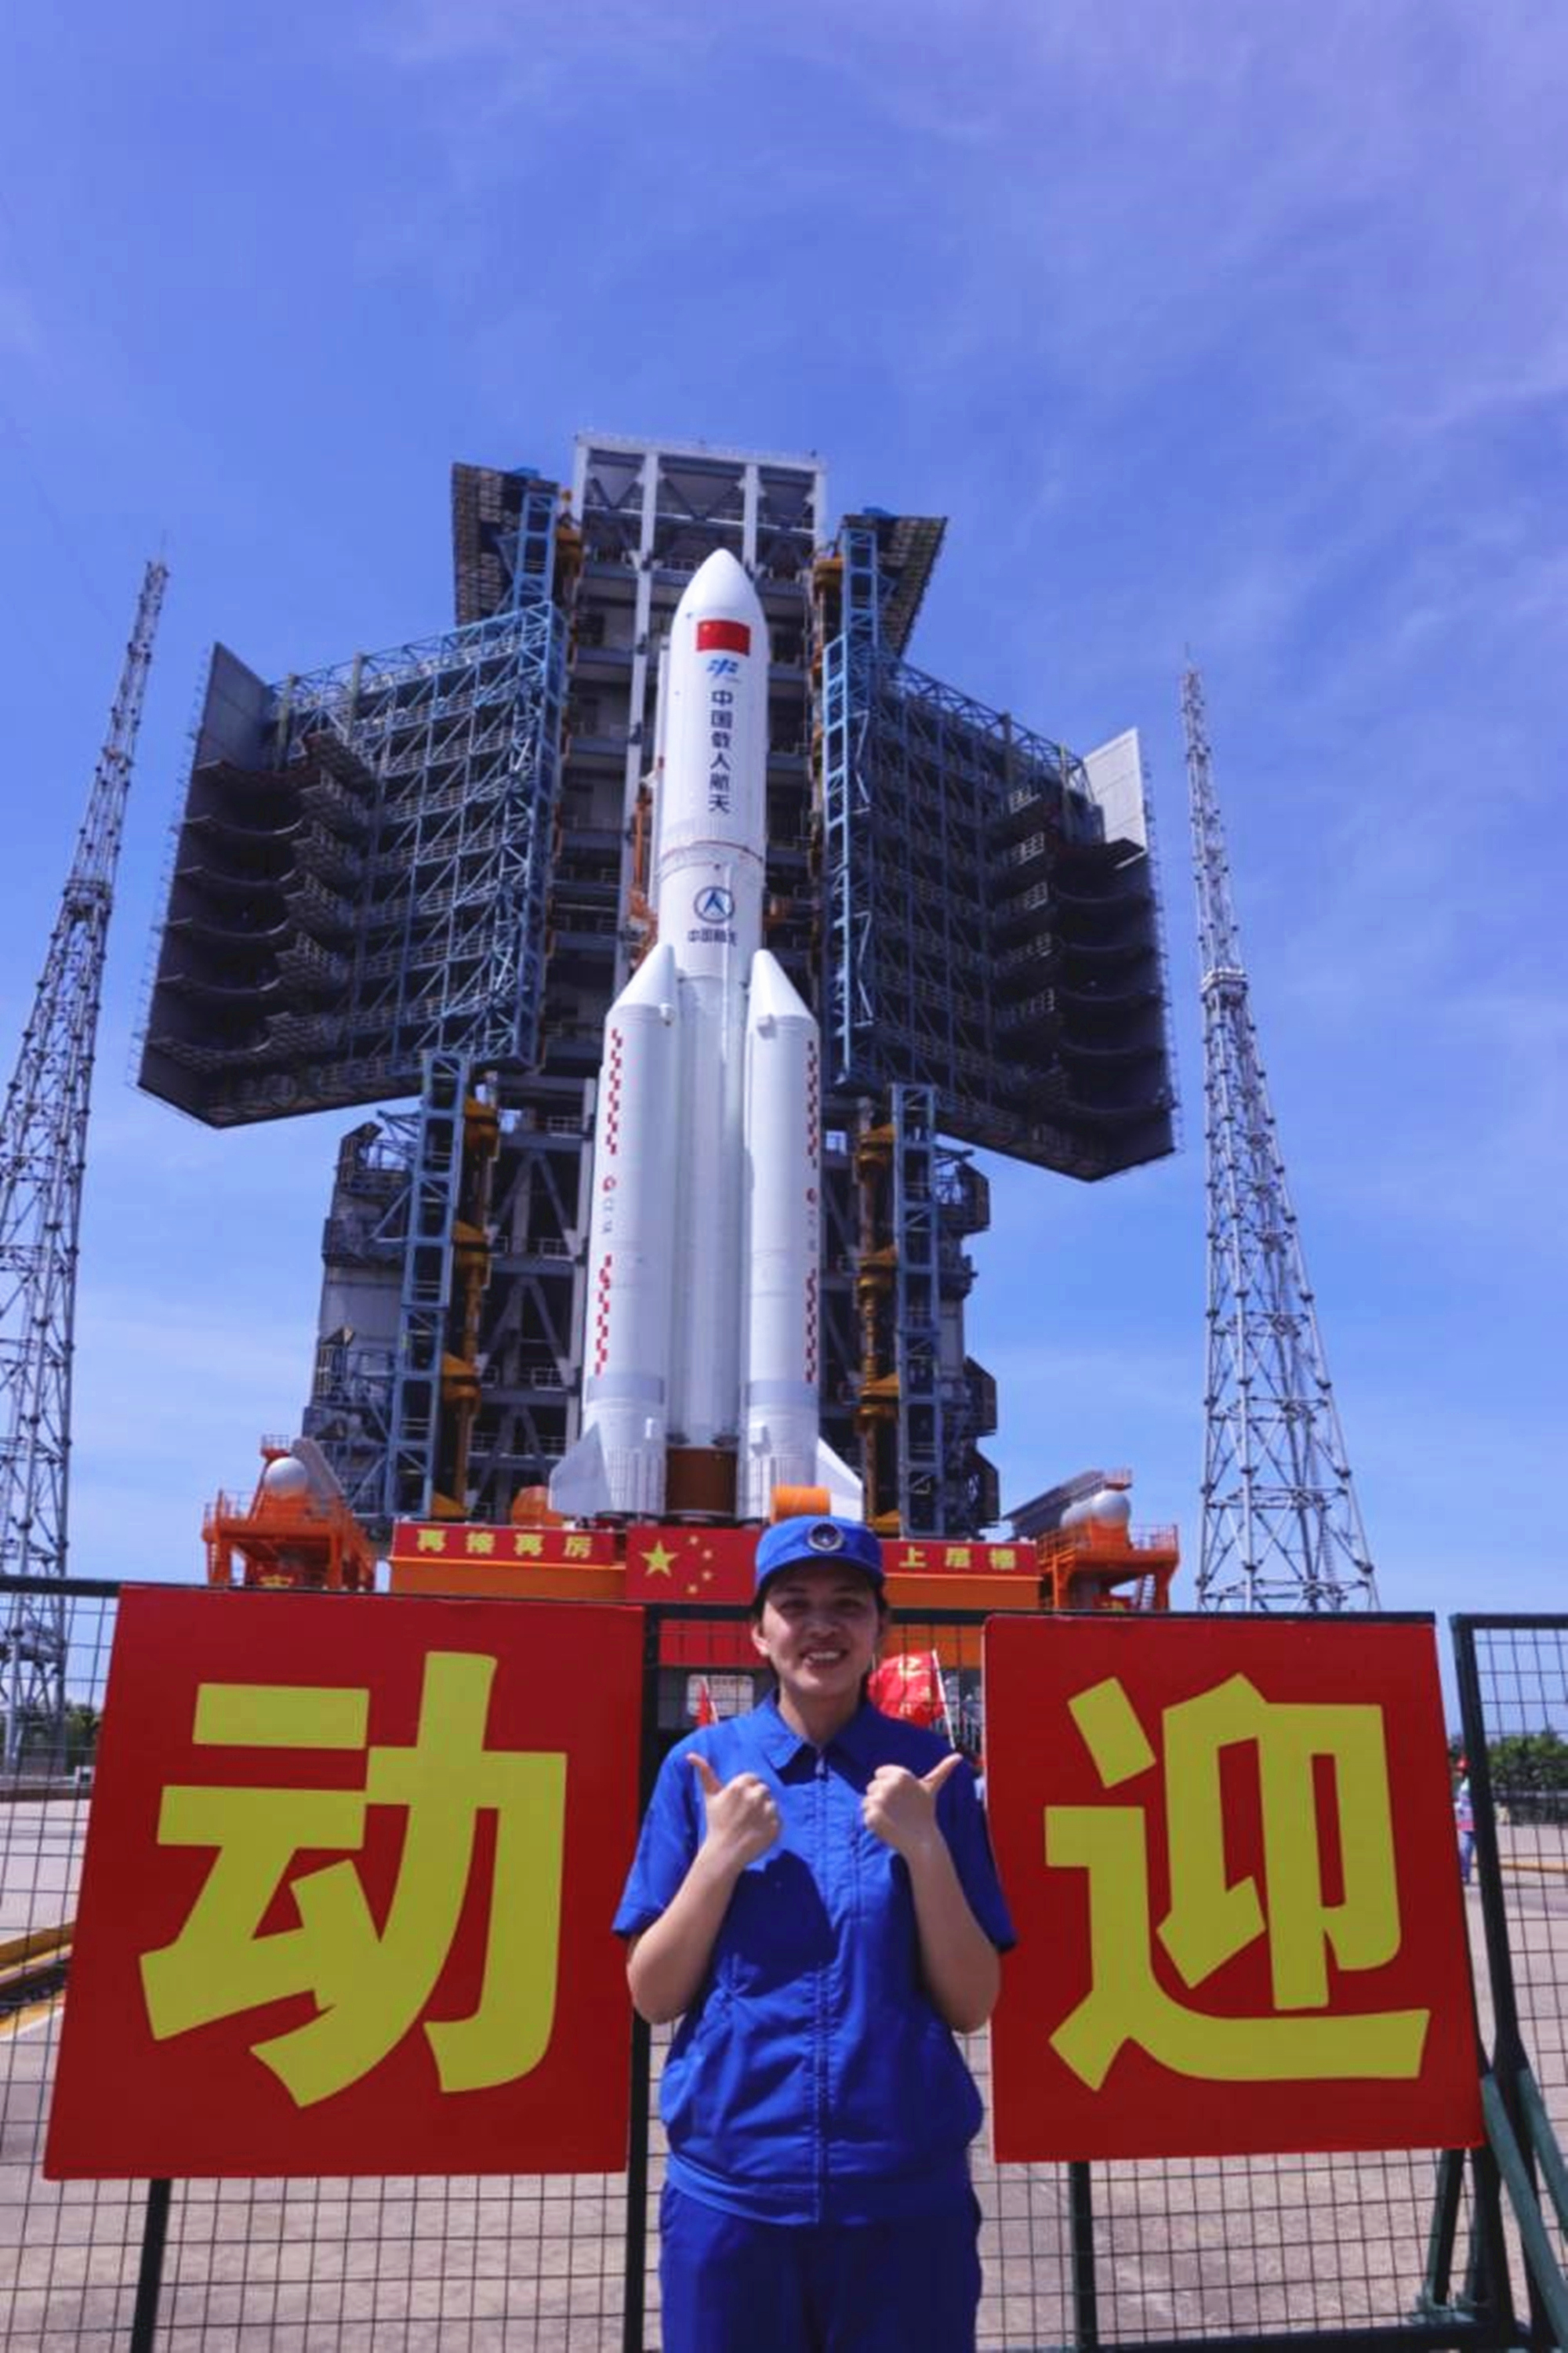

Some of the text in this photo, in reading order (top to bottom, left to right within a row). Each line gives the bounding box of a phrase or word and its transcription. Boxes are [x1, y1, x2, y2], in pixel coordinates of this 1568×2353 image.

[708, 689, 734, 814] 中国载人航天
[140, 1651, 568, 2108] 动
[1044, 1672, 1431, 2092] 迎
